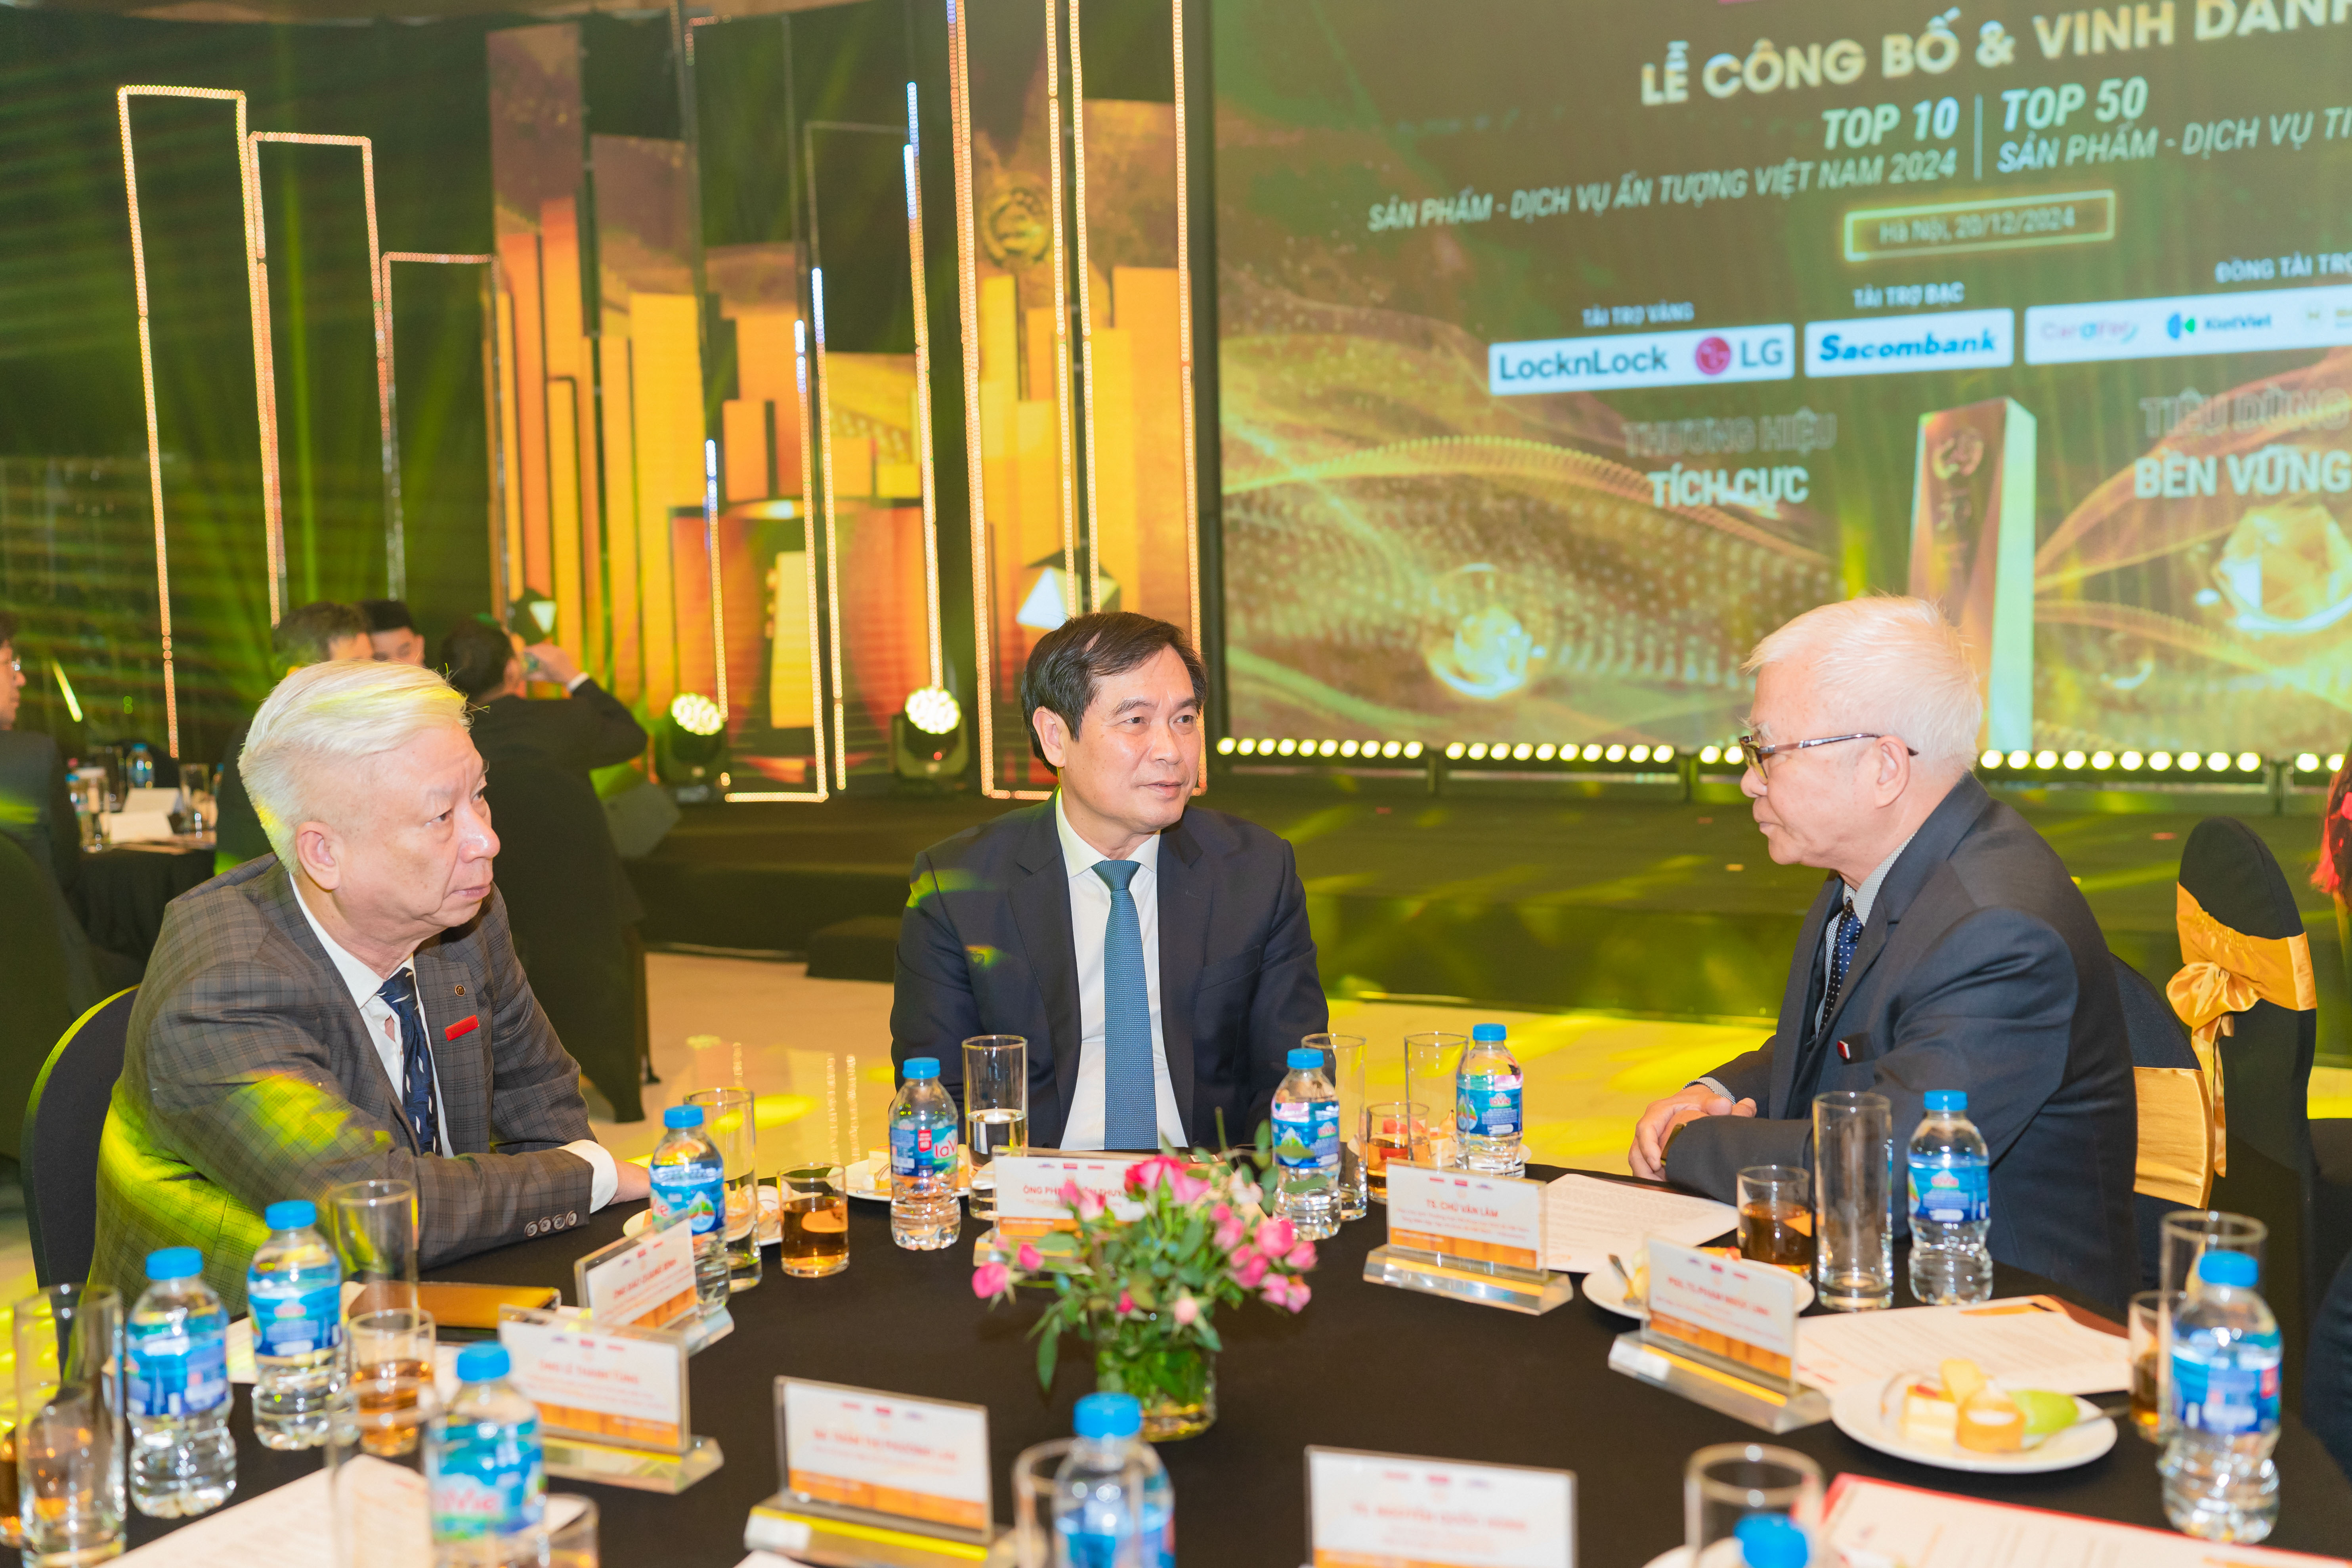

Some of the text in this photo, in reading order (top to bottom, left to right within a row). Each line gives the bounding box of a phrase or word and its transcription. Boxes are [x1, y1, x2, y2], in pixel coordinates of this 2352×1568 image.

[1641, 40, 1690, 106] LỄ
[1702, 38, 1867, 98] CÔNG
[1882, 6, 1961, 78] BỐ
[1976, 21, 2016, 67] &
[2033, 1, 2175, 59] VINH
[1821, 97, 1959, 150] TOP 10
[2000, 76, 2149, 132] TOP 50
[1997, 131, 2060, 173] SẢN
[2066, 120, 2159, 166] PHẨM
[2182, 116, 2261, 160] DỊCH
[2269, 110, 2315, 151] VỤ
[1368, 194, 1417, 232] SẢN
[1421, 185, 1493, 227] PHẨM
[1509, 187, 1570, 223] DỊCH
[1576, 182, 1611, 218] VỤ
[1613, 170, 1652, 208] ẤN
[1659, 168, 1748, 208] TƯỢNG
[1754, 157, 1814, 202] VIỆT
[1817, 155, 1885, 189] NAM
[1888, 148, 1958, 184] 2024
[2279, 250, 2313, 277] TÀI
[1499, 338, 1784, 381] LocknLock LG
[1820, 327, 1997, 361] Sacombank
[1647, 461, 1728, 508] TÍCH
[2134, 444, 2352, 499] BỀN VỮNG
